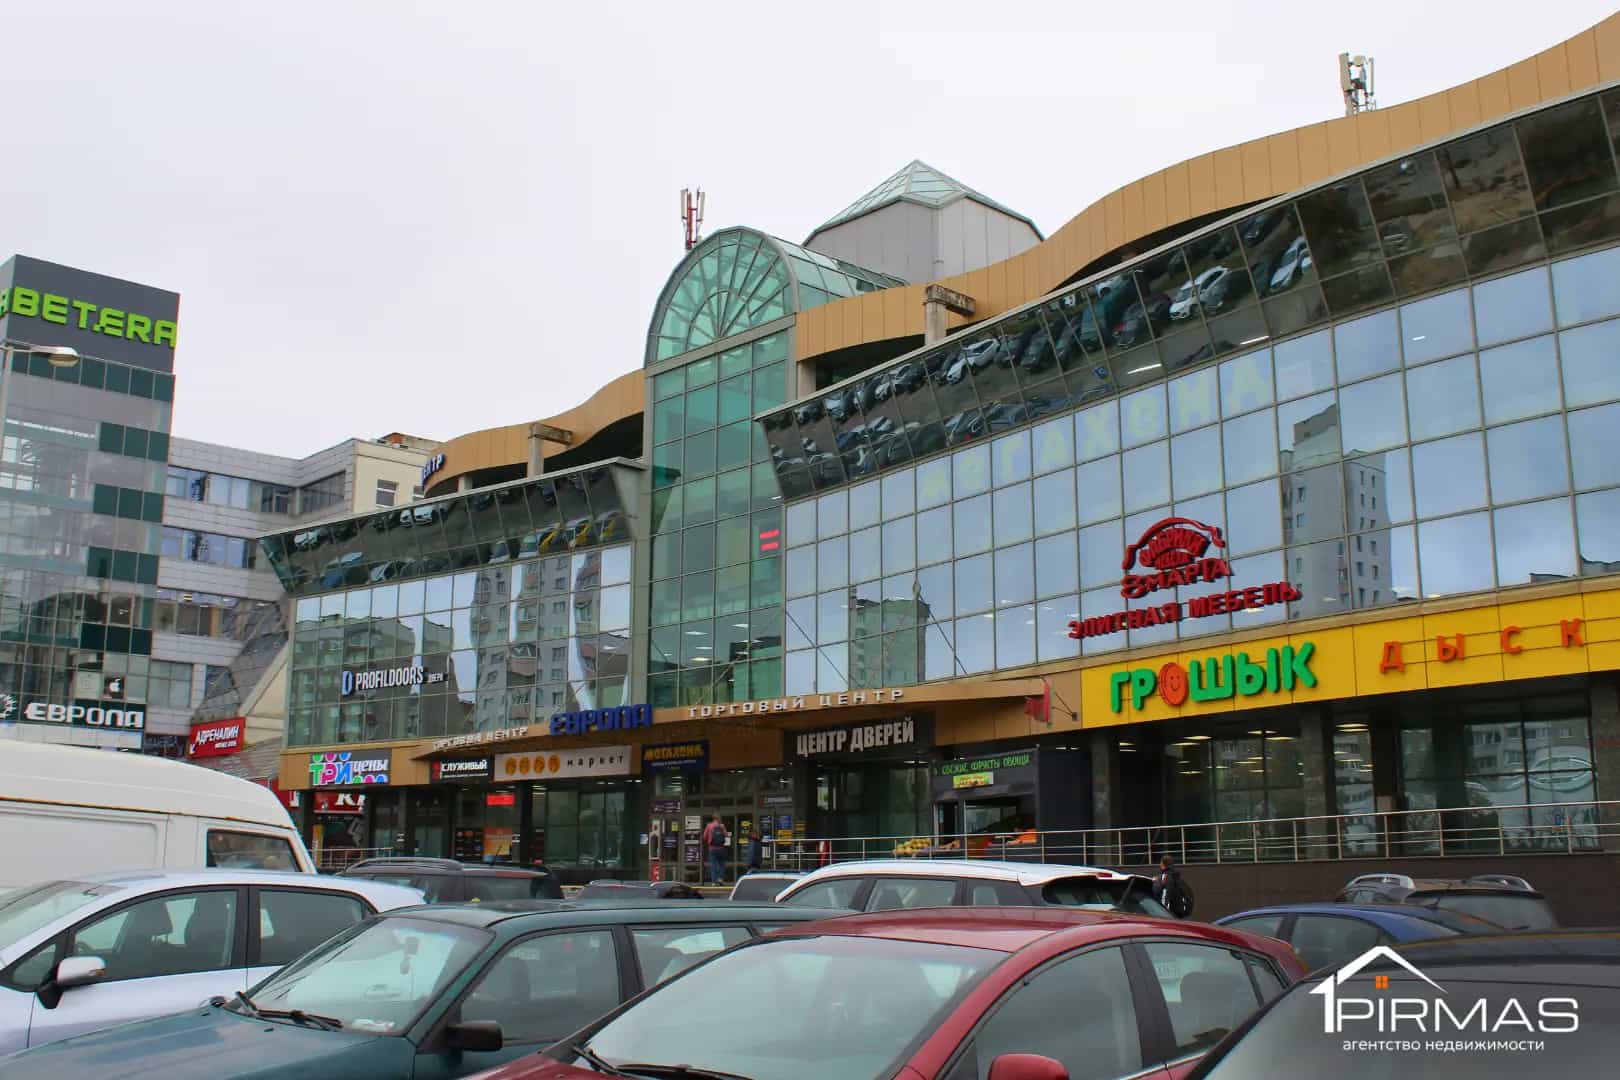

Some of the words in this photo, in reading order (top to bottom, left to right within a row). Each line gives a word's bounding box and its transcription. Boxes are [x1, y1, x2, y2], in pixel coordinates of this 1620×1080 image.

[1110, 641, 1319, 714] ГРОШЫК
[24, 702, 144, 728] ЕВРОПА
[549, 703, 653, 736] ЕВРОПА
[689, 695, 805, 718] ТОРГОВЫЙ
[820, 689, 904, 706] ЦЕНТР
[796, 730, 847, 757] ЦЕНТР
[850, 716, 914, 752] ДВЕРЕЙ
